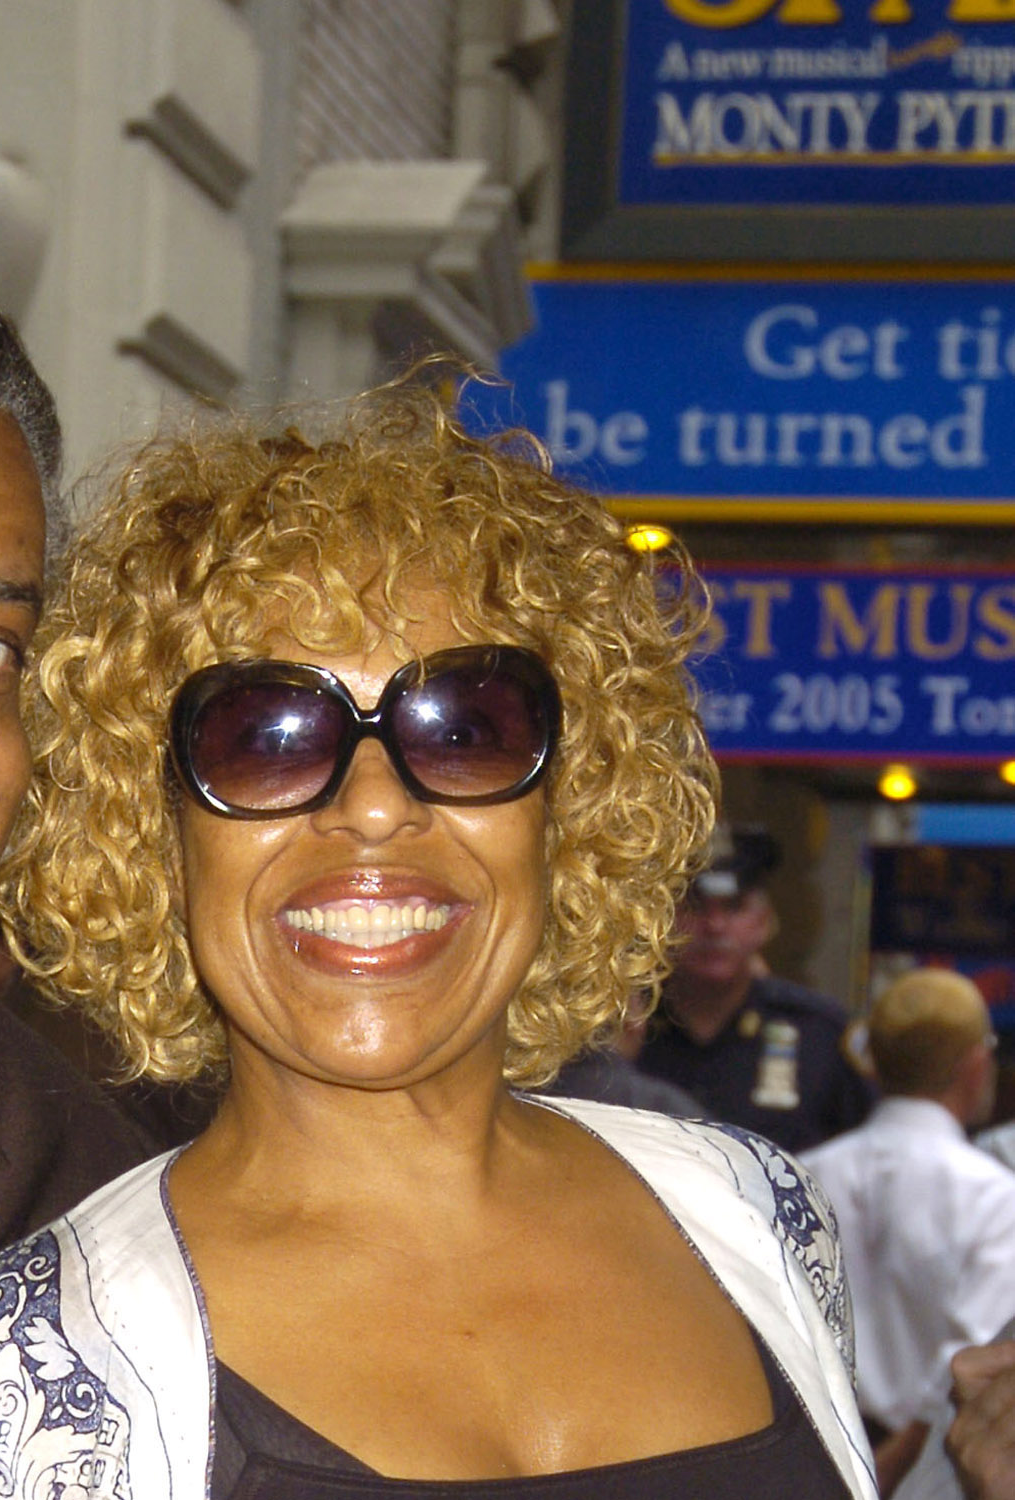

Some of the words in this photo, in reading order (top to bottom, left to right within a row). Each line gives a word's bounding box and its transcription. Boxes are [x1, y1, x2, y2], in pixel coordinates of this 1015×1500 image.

[658, 42, 689, 81] A
[691, 49, 763, 80] new
[767, 35, 887, 79] musical
[952, 41, 1015, 88] ripp
[654, 91, 882, 155] MONTY
[894, 90, 1015, 155] PYT
[743, 304, 908, 381] Get
[939, 306, 1015, 381] ti
[546, 379, 649, 466] be
[680, 384, 987, 469] turned
[670, 579, 792, 659] ST
[697, 692, 754, 735] er
[768, 672, 904, 736] 2005
